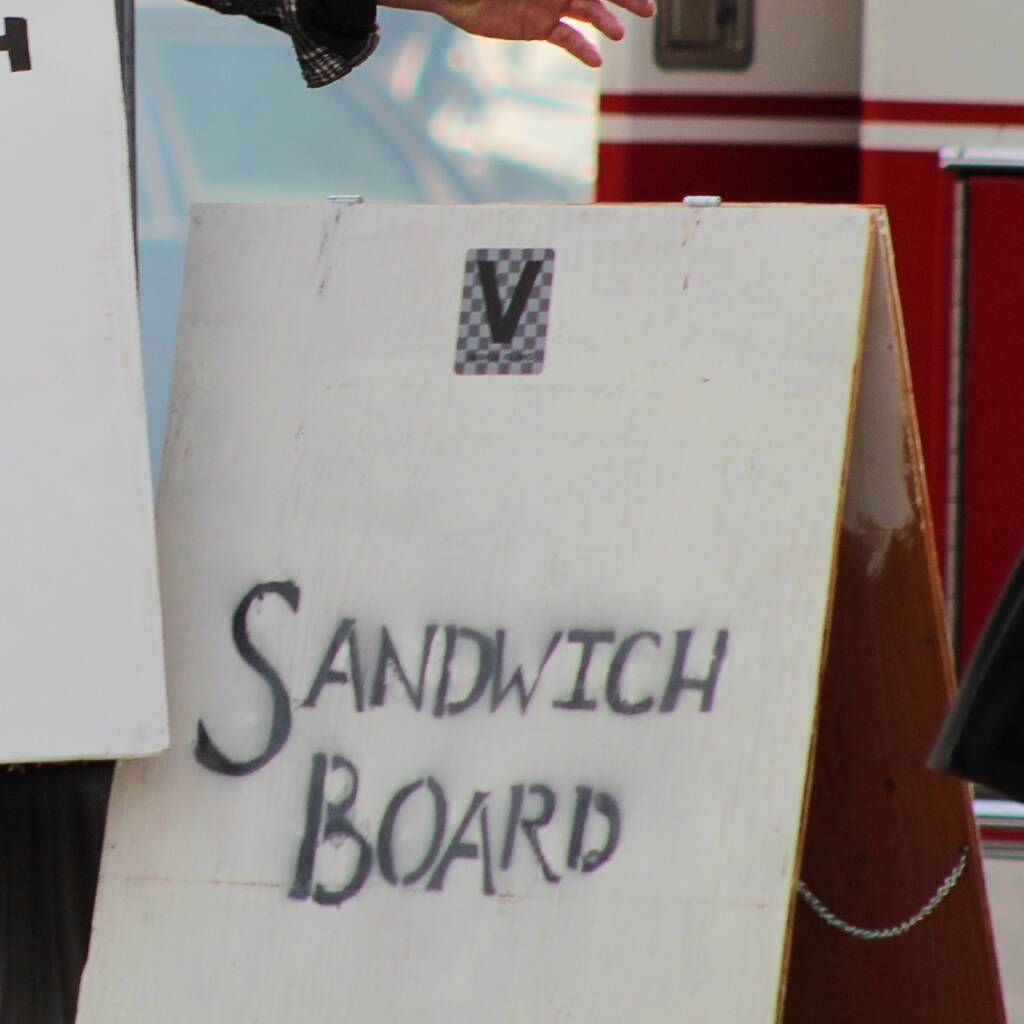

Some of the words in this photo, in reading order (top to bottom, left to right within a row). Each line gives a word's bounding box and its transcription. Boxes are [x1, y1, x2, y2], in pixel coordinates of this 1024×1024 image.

[477, 260, 543, 344] V
[193, 579, 731, 777] SANDWICH
[286, 752, 624, 907] BOARD
